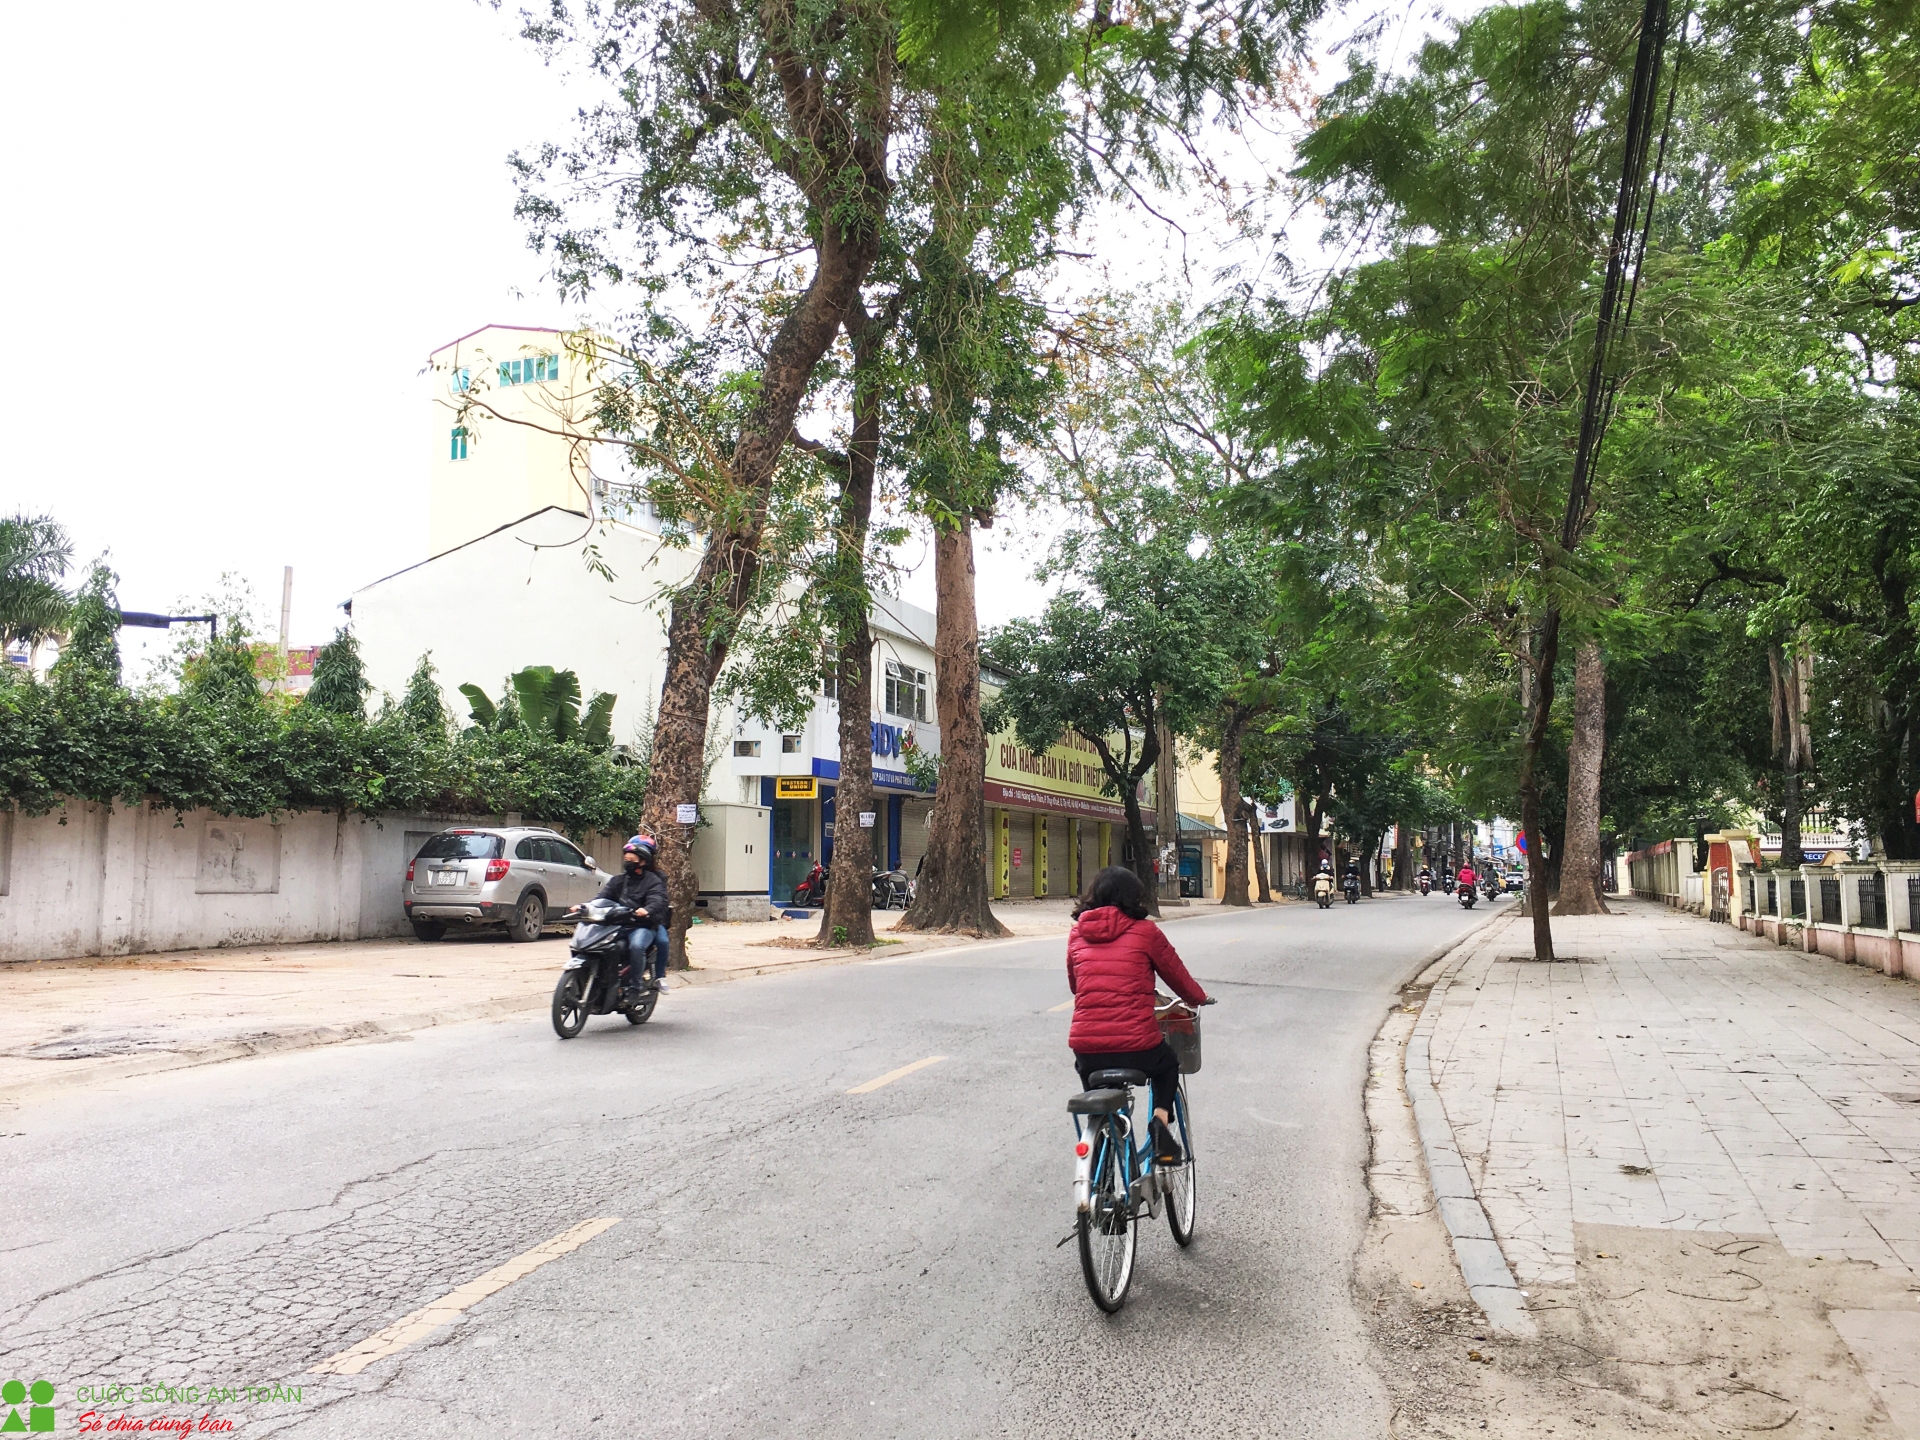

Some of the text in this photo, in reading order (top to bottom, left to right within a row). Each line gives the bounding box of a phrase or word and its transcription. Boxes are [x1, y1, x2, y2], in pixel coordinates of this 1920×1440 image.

[871, 721, 903, 759] BIDV
[1000, 737, 1017, 771] CỬA
[1041, 752, 1057, 780] BÁN
[1058, 754, 1068, 782] VÀ
[1068, 758, 1082, 784] GIỚI
